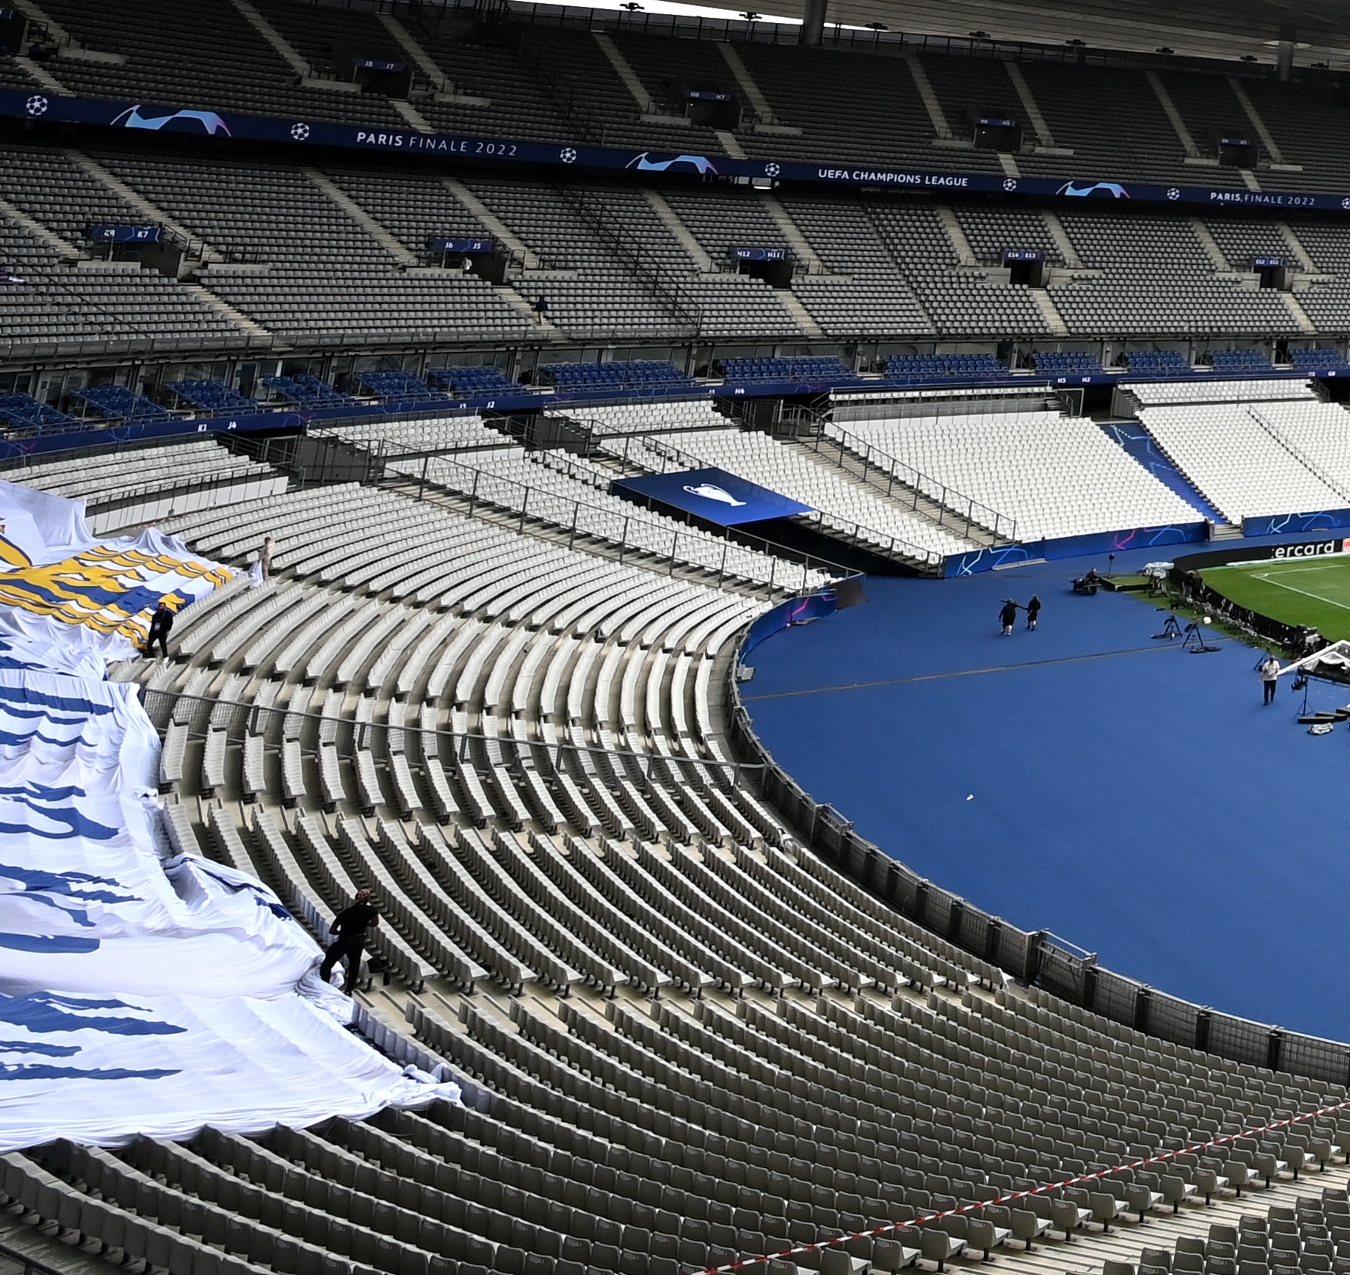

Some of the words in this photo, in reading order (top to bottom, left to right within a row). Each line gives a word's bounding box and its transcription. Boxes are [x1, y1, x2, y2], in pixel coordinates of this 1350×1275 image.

[357, 132, 403, 146] PARIS
[409, 136, 468, 152] FINALE
[475, 142, 517, 156] 2022
[818, 168, 850, 180] UEFA
[852, 170, 921, 184] CHAMPIONS
[925, 175, 968, 187] LEAGUE
[1210, 192, 1240, 201] PARIS
[1244, 194, 1283, 204] FINALE
[1287, 196, 1315, 205] 2022
[137, 230, 149, 238] K7
[486, 401, 495, 409] J2
[1270, 540, 1335, 559] ercard
